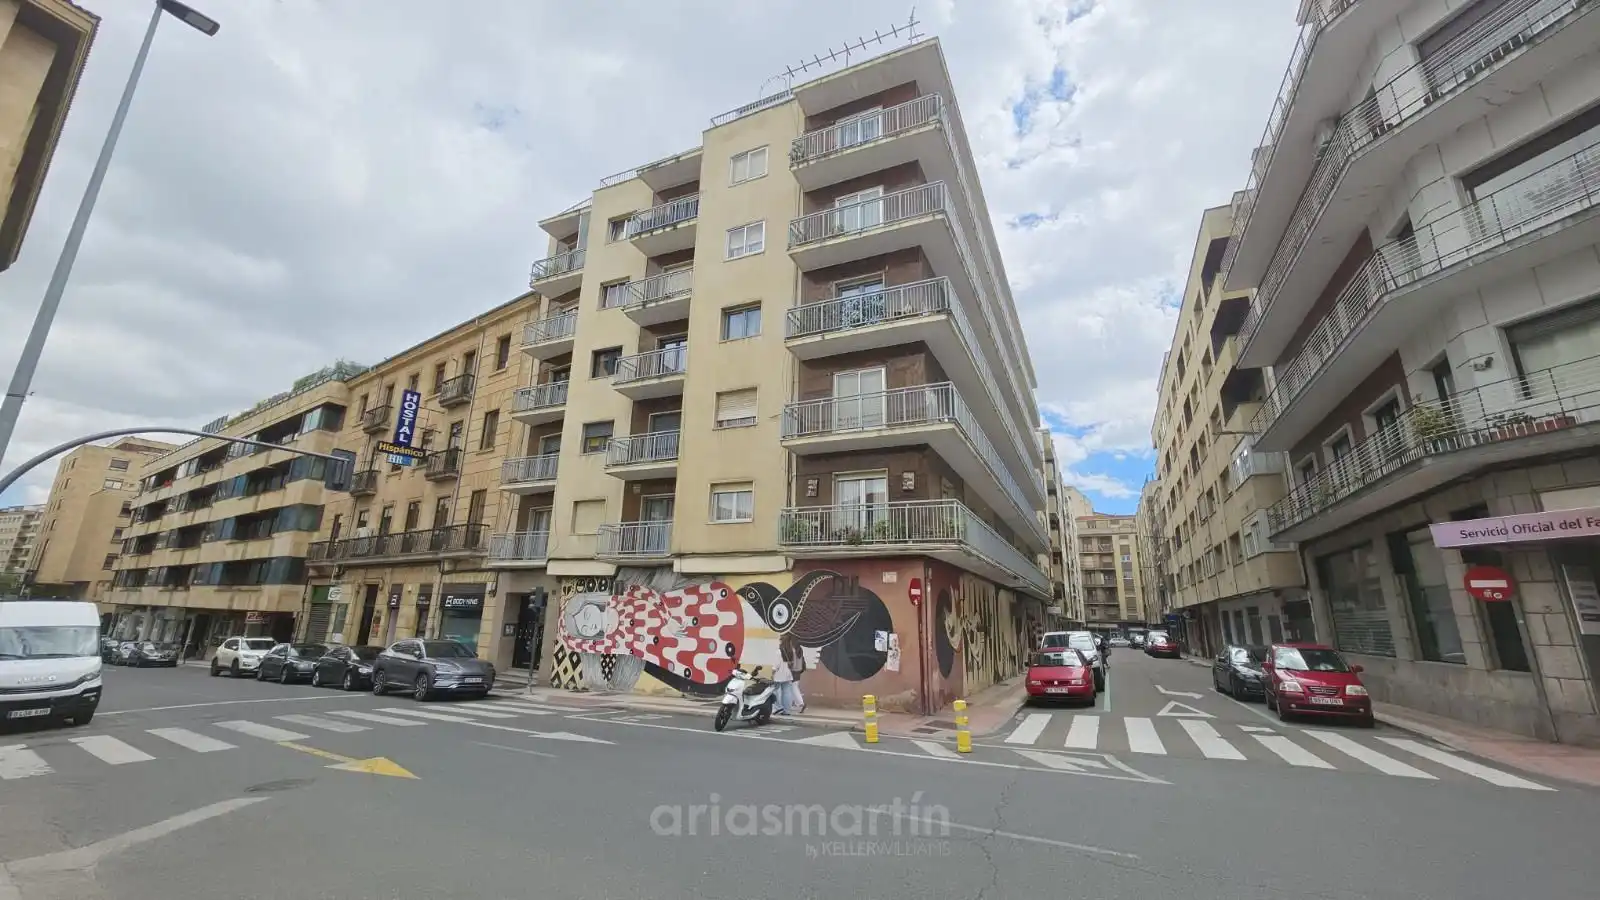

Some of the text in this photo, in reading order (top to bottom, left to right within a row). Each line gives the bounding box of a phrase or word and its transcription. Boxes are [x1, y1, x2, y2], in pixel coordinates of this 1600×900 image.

[399, 393, 418, 443] HOSTAL
[379, 442, 424, 457] Hispánico
[1460, 524, 1509, 539] Servicio
[1512, 519, 1555, 535] Oficial
[1559, 518, 1582, 530] del
